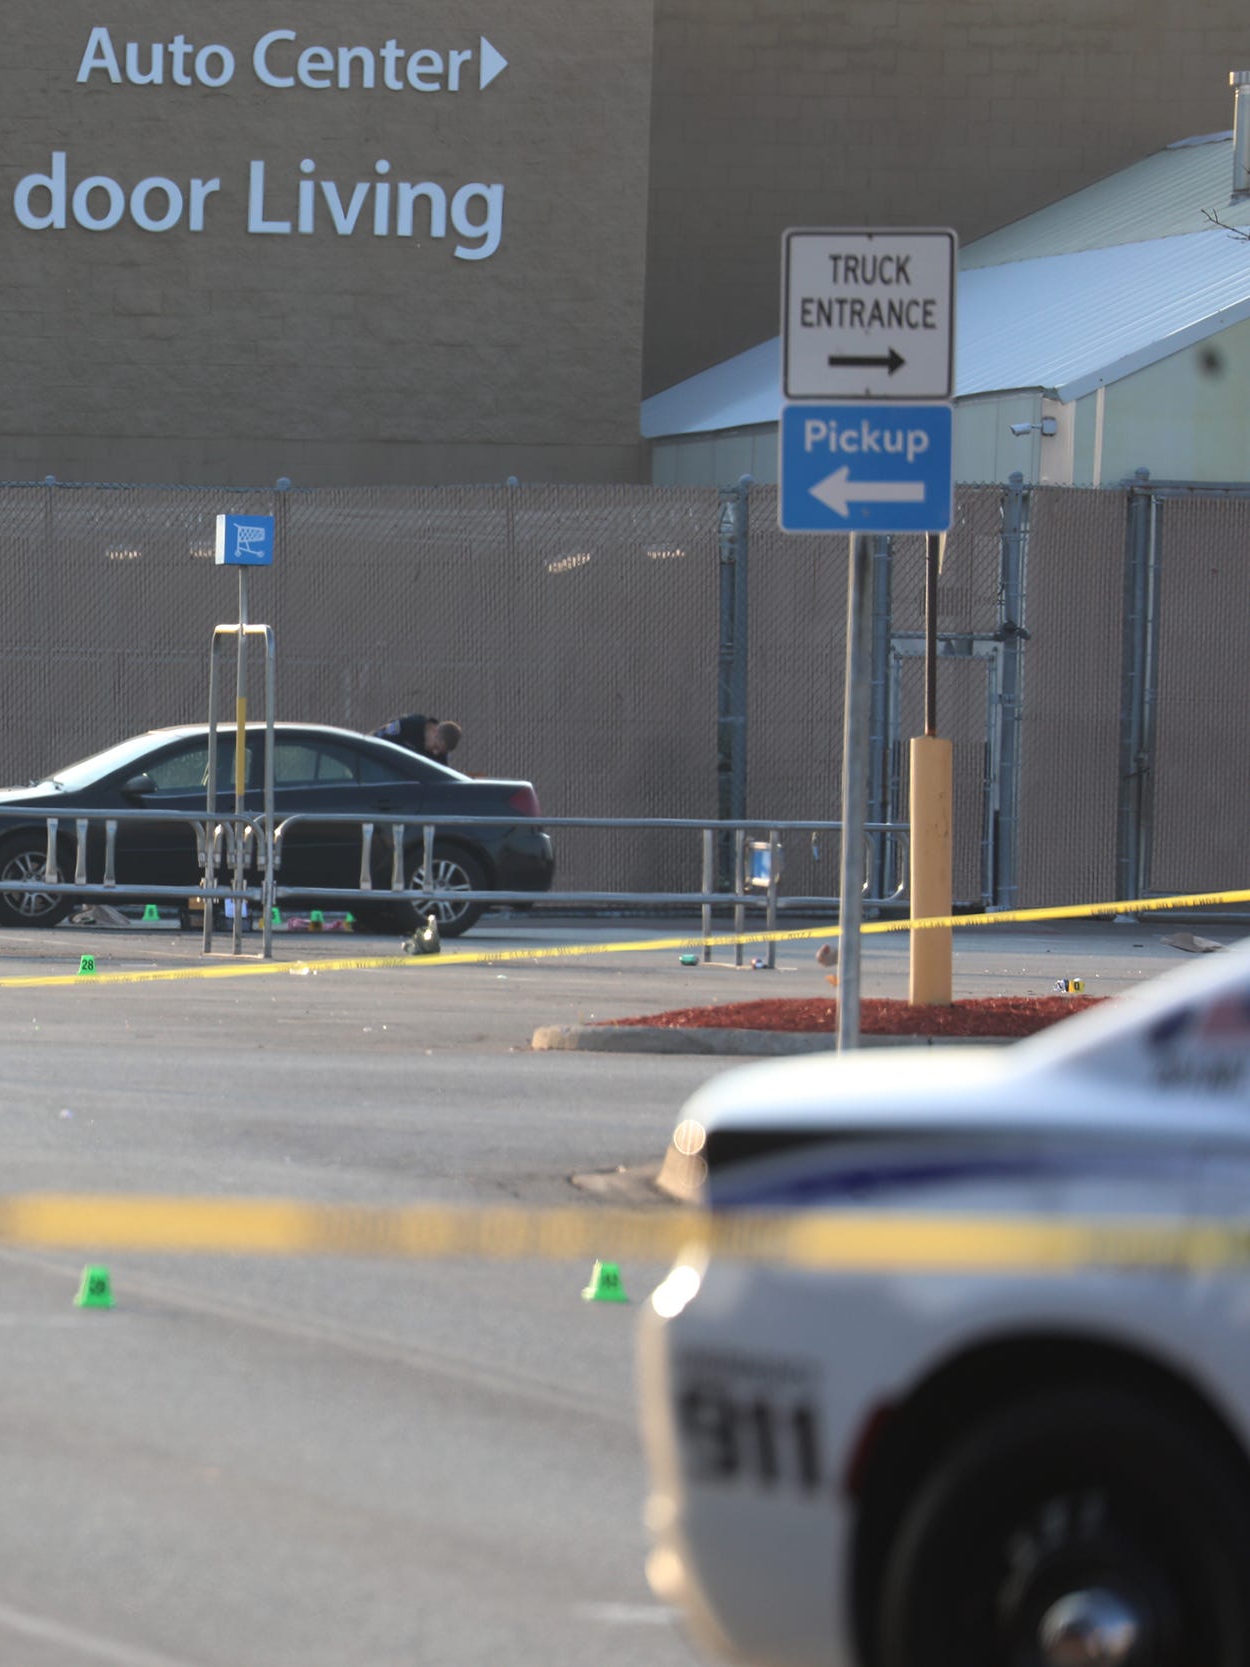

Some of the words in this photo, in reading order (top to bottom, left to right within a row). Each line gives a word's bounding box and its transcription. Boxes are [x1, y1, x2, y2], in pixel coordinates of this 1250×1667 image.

[76, 26, 236, 88] Auto
[253, 29, 472, 92] Center
[248, 158, 505, 261] Living
[828, 254, 912, 285] TRUCK
[800, 298, 938, 330] ENTRANCE
[803, 419, 929, 463] Pickup
[81, 959, 95, 971] 28
